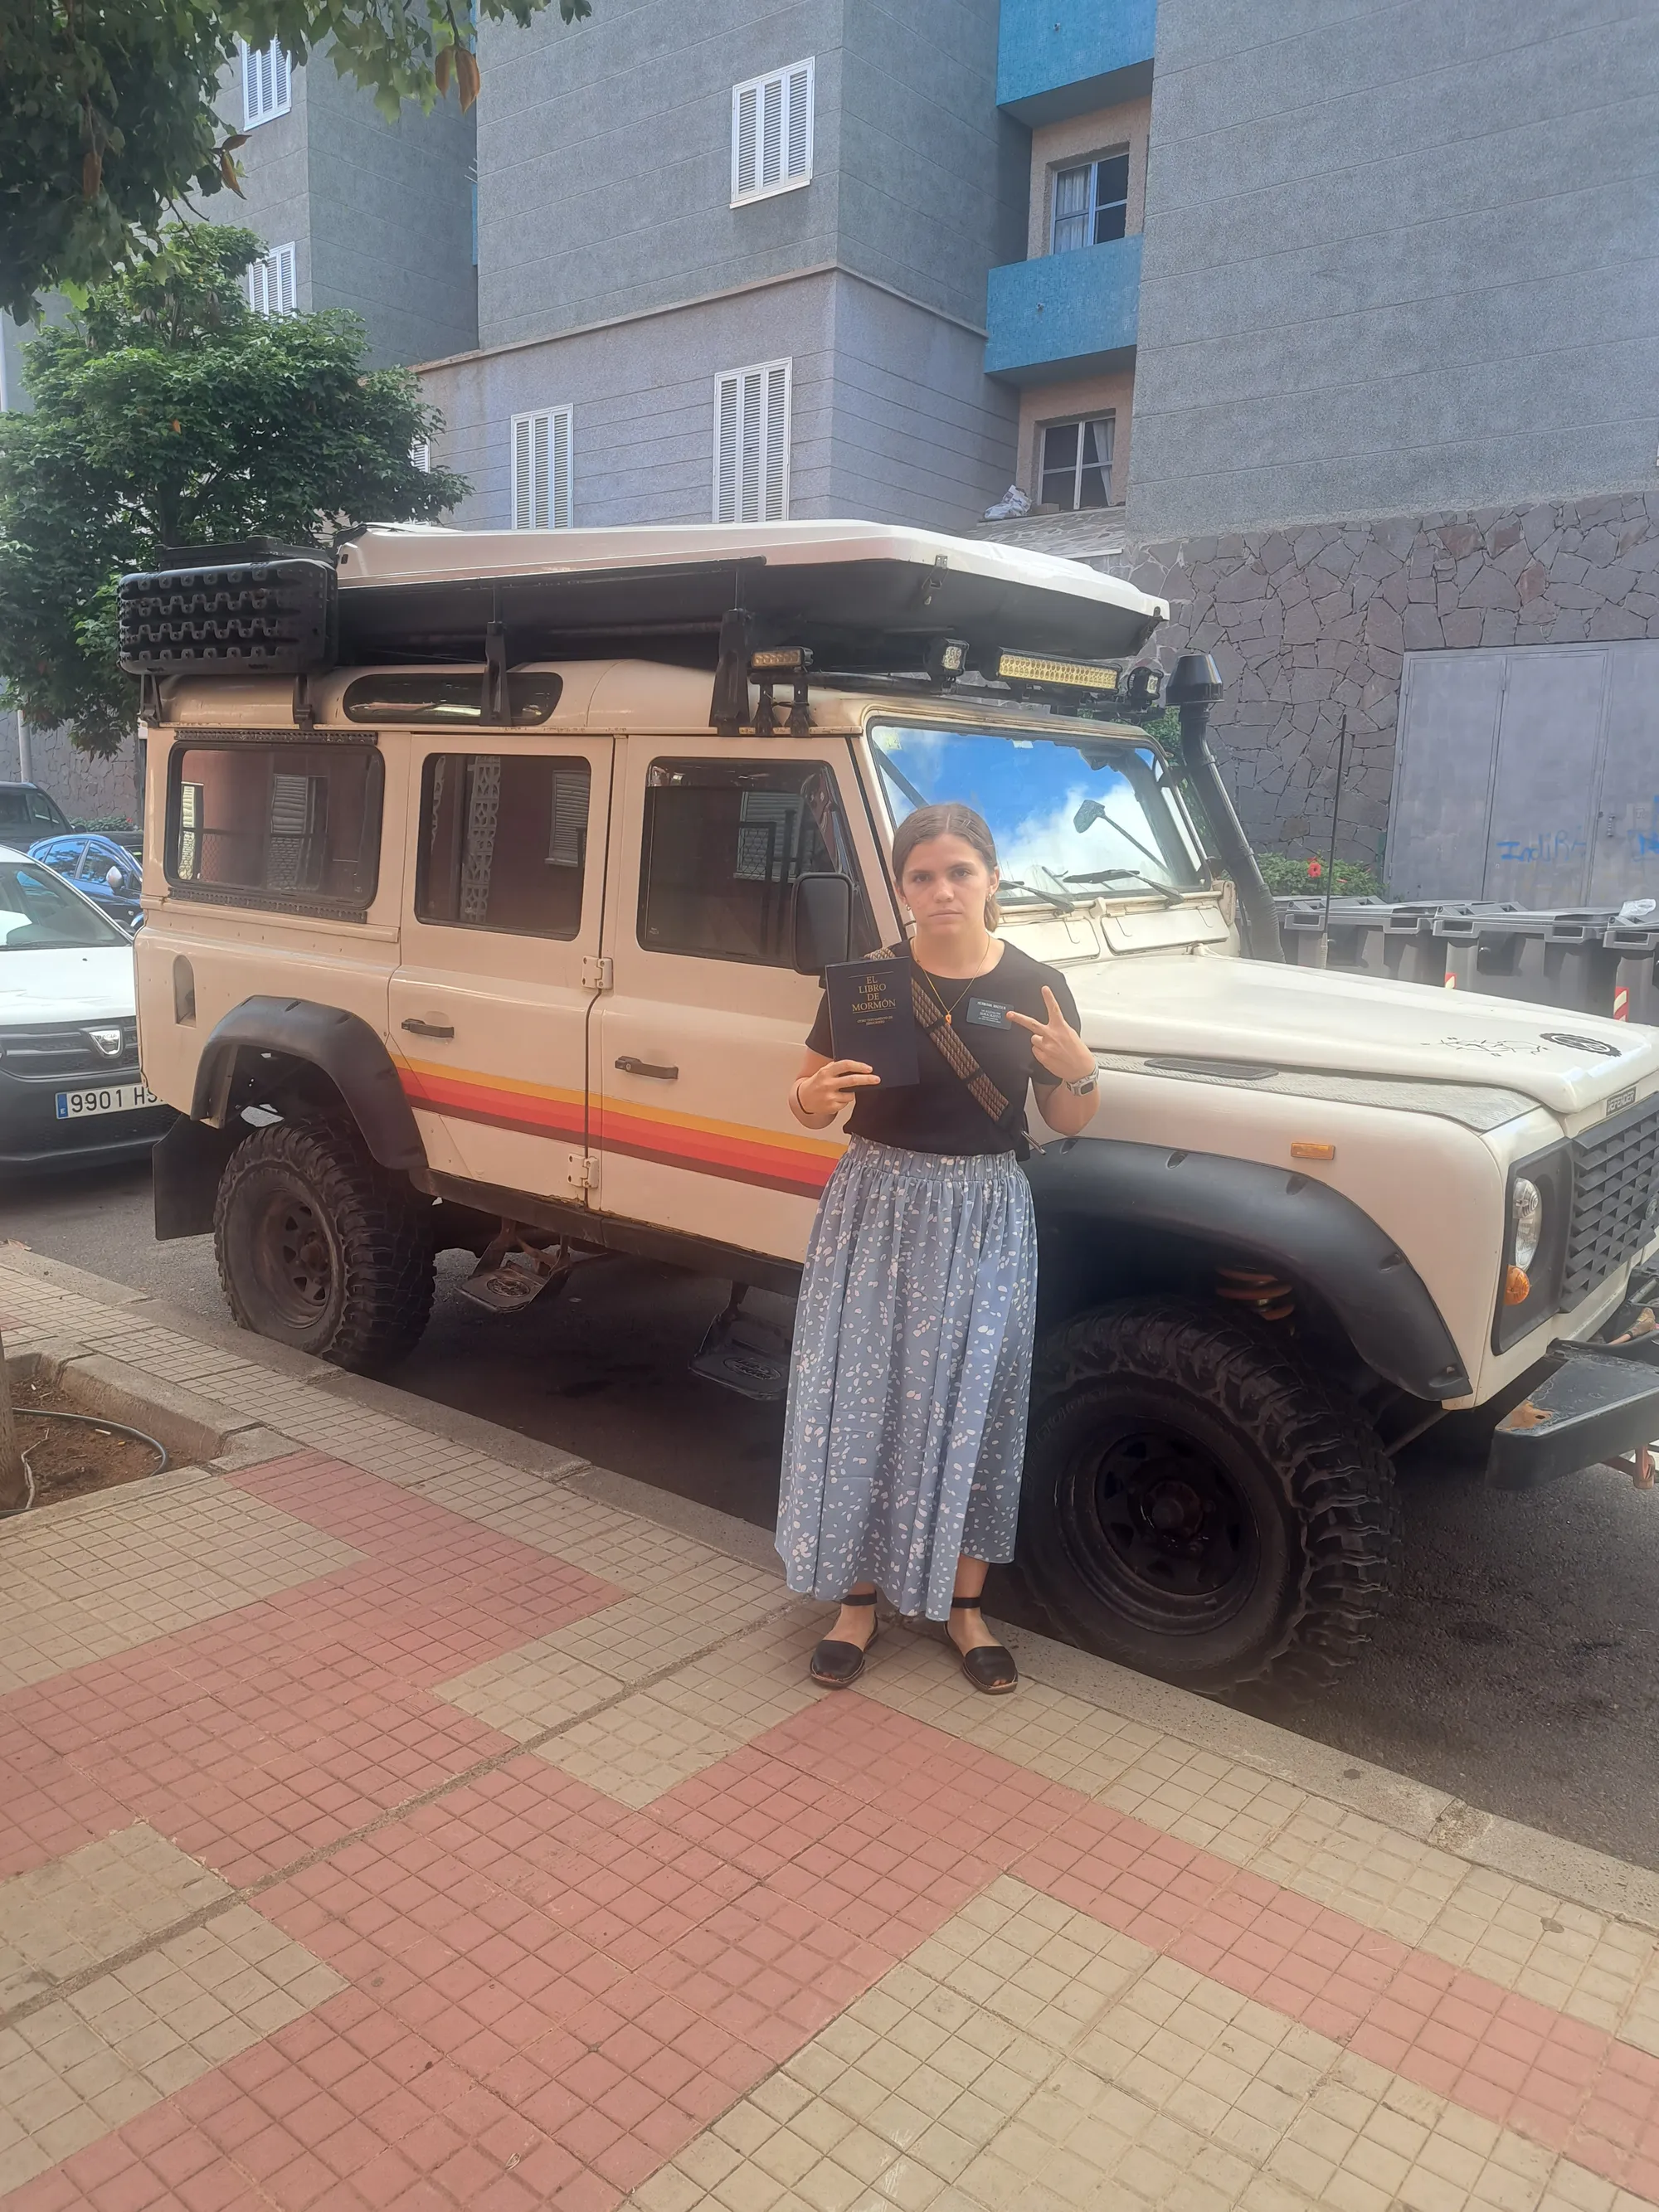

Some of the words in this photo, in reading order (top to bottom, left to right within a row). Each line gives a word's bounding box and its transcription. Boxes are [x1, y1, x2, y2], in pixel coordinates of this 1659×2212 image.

[867, 976, 878, 984] EL
[859, 984, 887, 994] LIBRO
[867, 993, 879, 1002] DE
[852, 999, 896, 1012] MORMÓN
[71, 1089, 122, 1113] 9901
[134, 1085, 163, 1106] HS
[1608, 1089, 1635, 1113] DEFENDER
